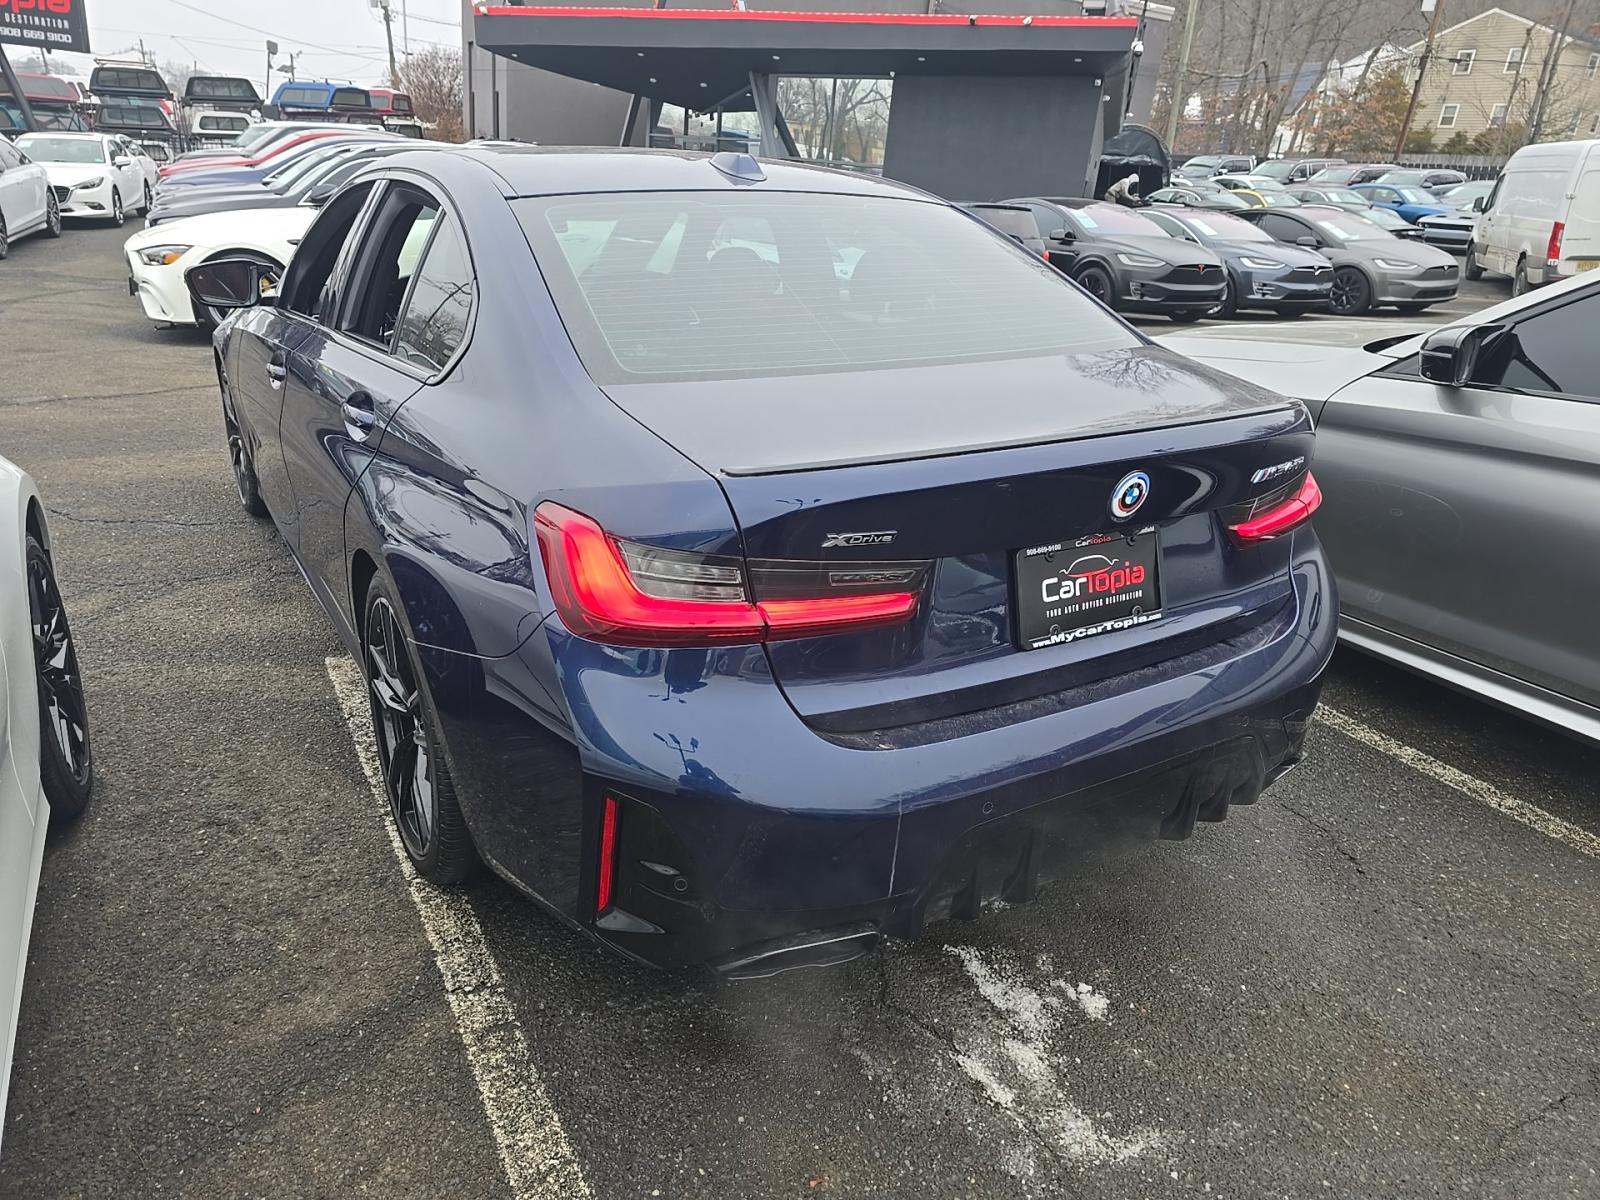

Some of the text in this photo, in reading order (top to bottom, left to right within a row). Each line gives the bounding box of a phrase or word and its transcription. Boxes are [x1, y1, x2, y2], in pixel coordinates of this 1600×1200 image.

[4, 12, 70, 30] DESTINATION
[0, 26, 72, 43] 908 669 9100
[1075, 535, 1112, 547] CarTopia
[1041, 561, 1145, 603] CarTopia
[1064, 603, 1079, 614] AUTO
[1032, 612, 1162, 648] www.MyCarTopia.com
